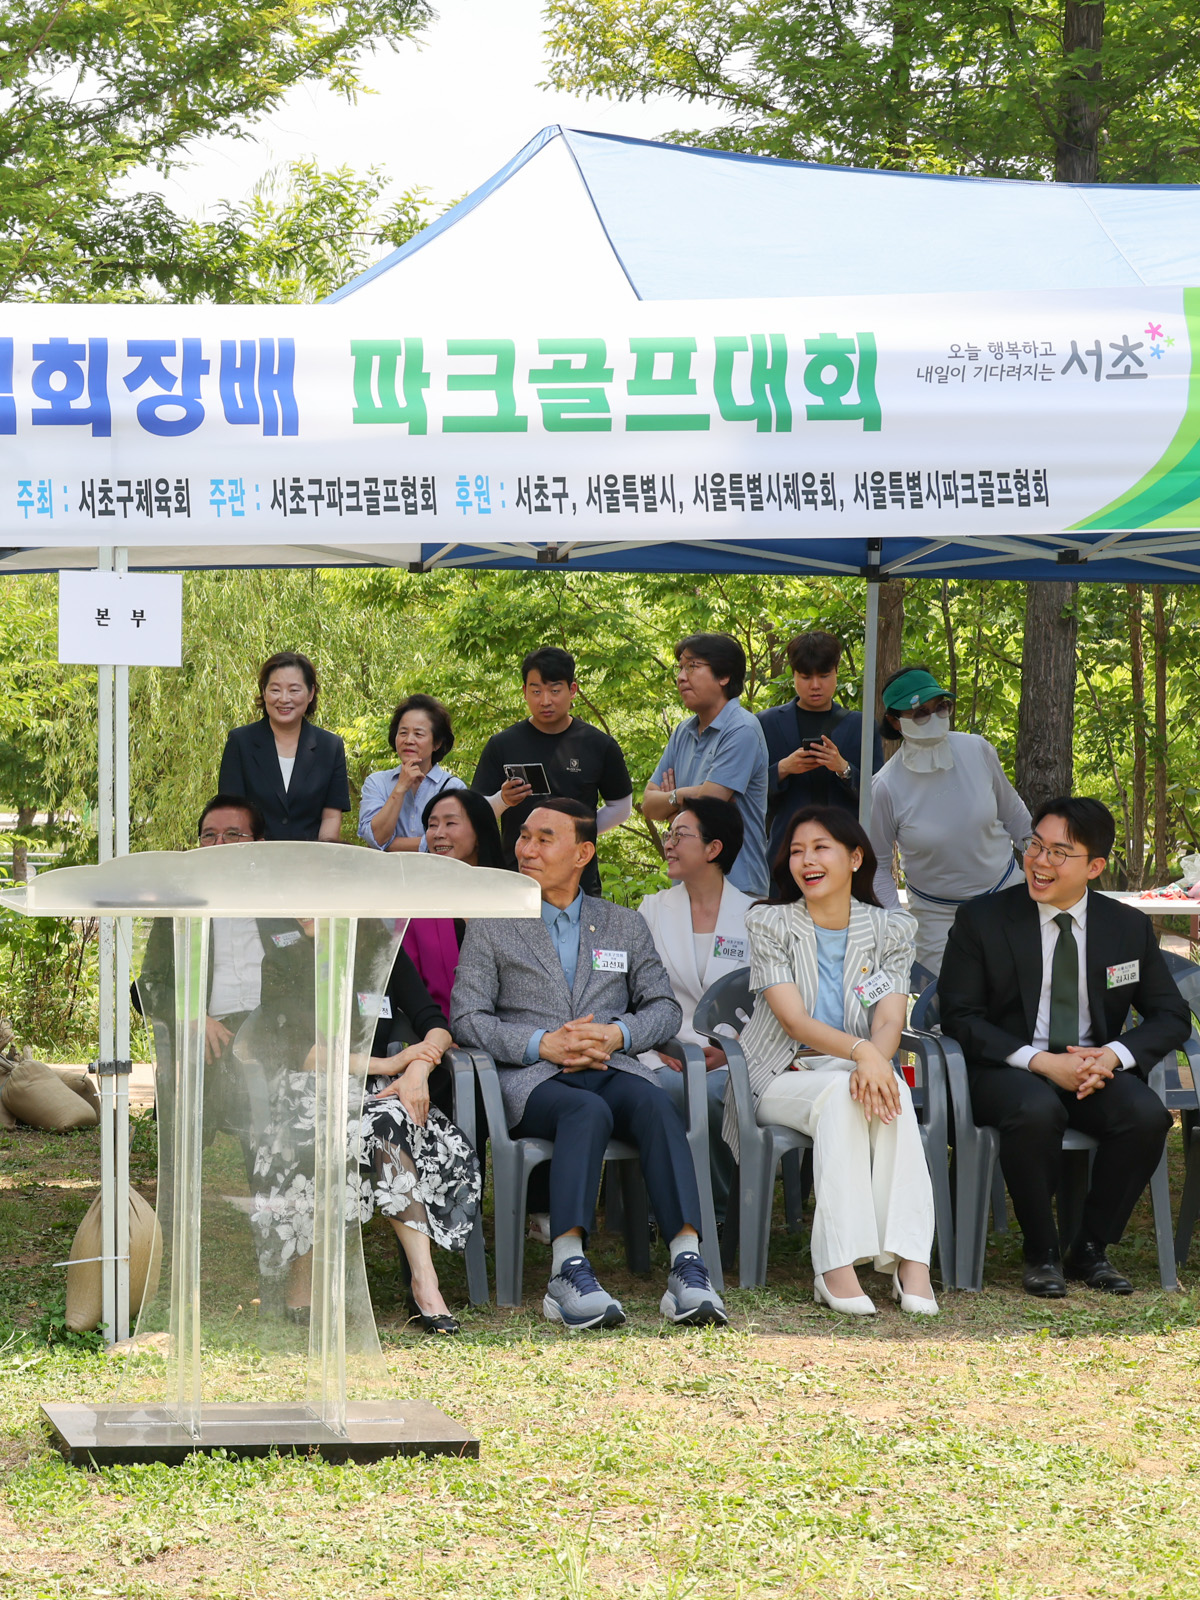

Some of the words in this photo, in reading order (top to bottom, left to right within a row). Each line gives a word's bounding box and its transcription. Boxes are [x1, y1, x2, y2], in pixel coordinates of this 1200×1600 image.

[947, 342, 982, 361] 오늘
[987, 340, 1057, 361] 행복하고
[1060, 334, 1149, 383] 서초
[350, 331, 883, 436] 파크골프대회
[916, 364, 967, 384] 내일이
[973, 363, 1056, 383] 기다려지는
[17, 479, 54, 519] 주최
[78, 477, 191, 519] 서초구체육회
[209, 477, 246, 518] 주관
[270, 475, 438, 518] 서초구파크골프협회
[455, 474, 492, 515] 후원
[515, 475, 577, 516] 서초구,
[585, 473, 684, 515] 서울특별시,
[692, 471, 844, 513] 서울특별시체육회,
[853, 468, 1050, 511] 서울특별시파크골프협회
[94, 607, 111, 627] 본
[130, 609, 147, 629] 부
[722, 947, 744, 958] 이은경
[601, 960, 625, 970] 고선재
[1115, 972, 1137, 984] 김지훈
[868, 981, 891, 1000] 이효진
